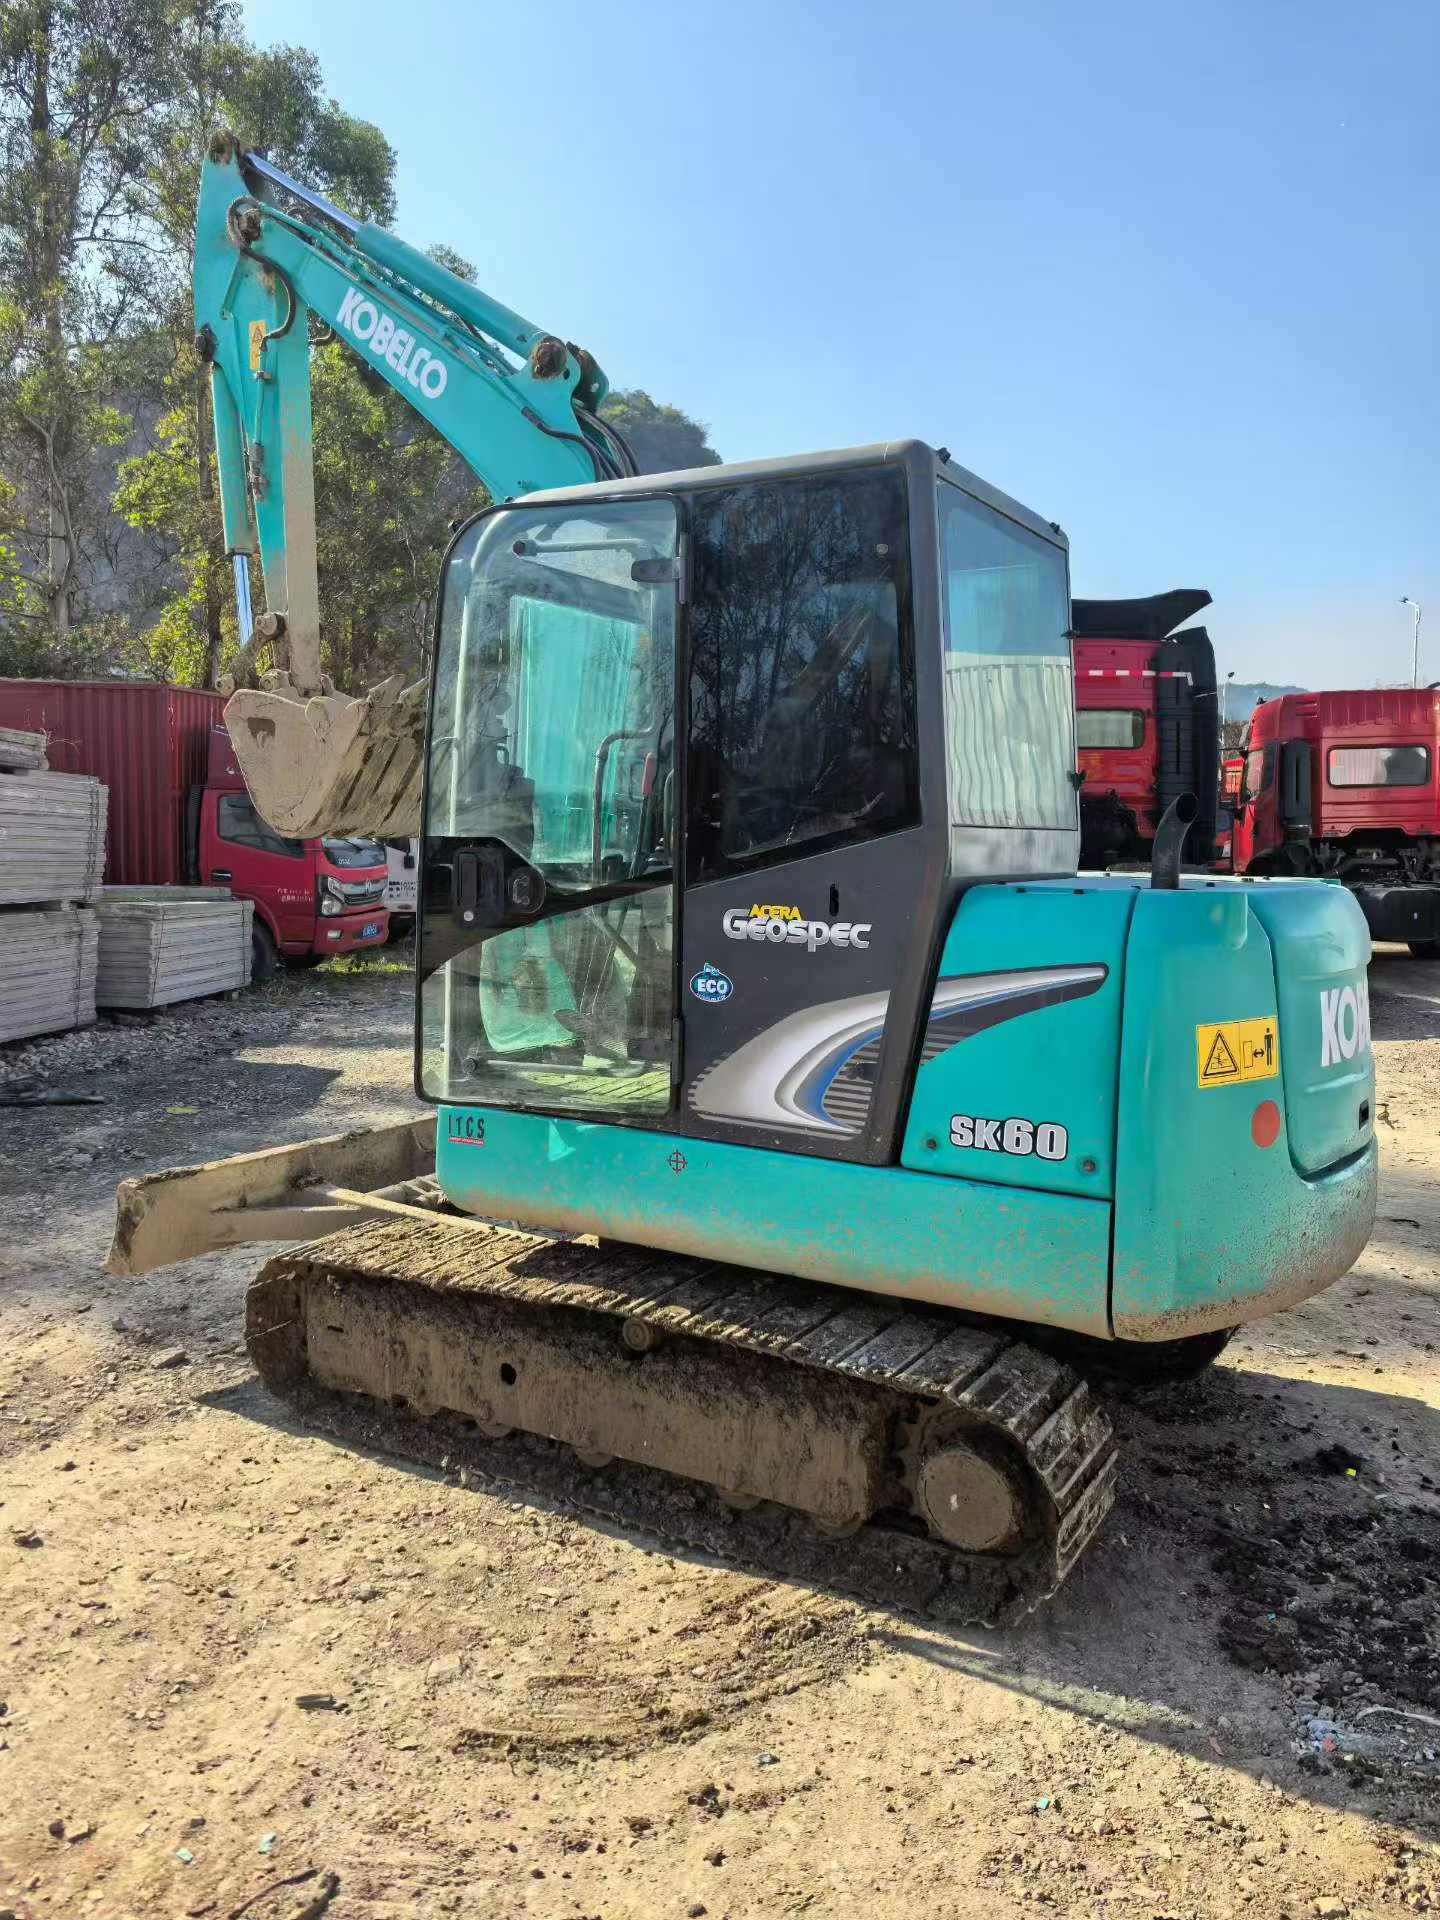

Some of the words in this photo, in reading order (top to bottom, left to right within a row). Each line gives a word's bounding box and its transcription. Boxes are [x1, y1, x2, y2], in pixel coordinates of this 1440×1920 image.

[336, 286, 448, 399] KOBELCO
[750, 904, 801, 921] ACERA
[697, 978, 728, 995] ECO
[448, 1114, 485, 1139] ITCS
[950, 1114, 1068, 1161] SK60
